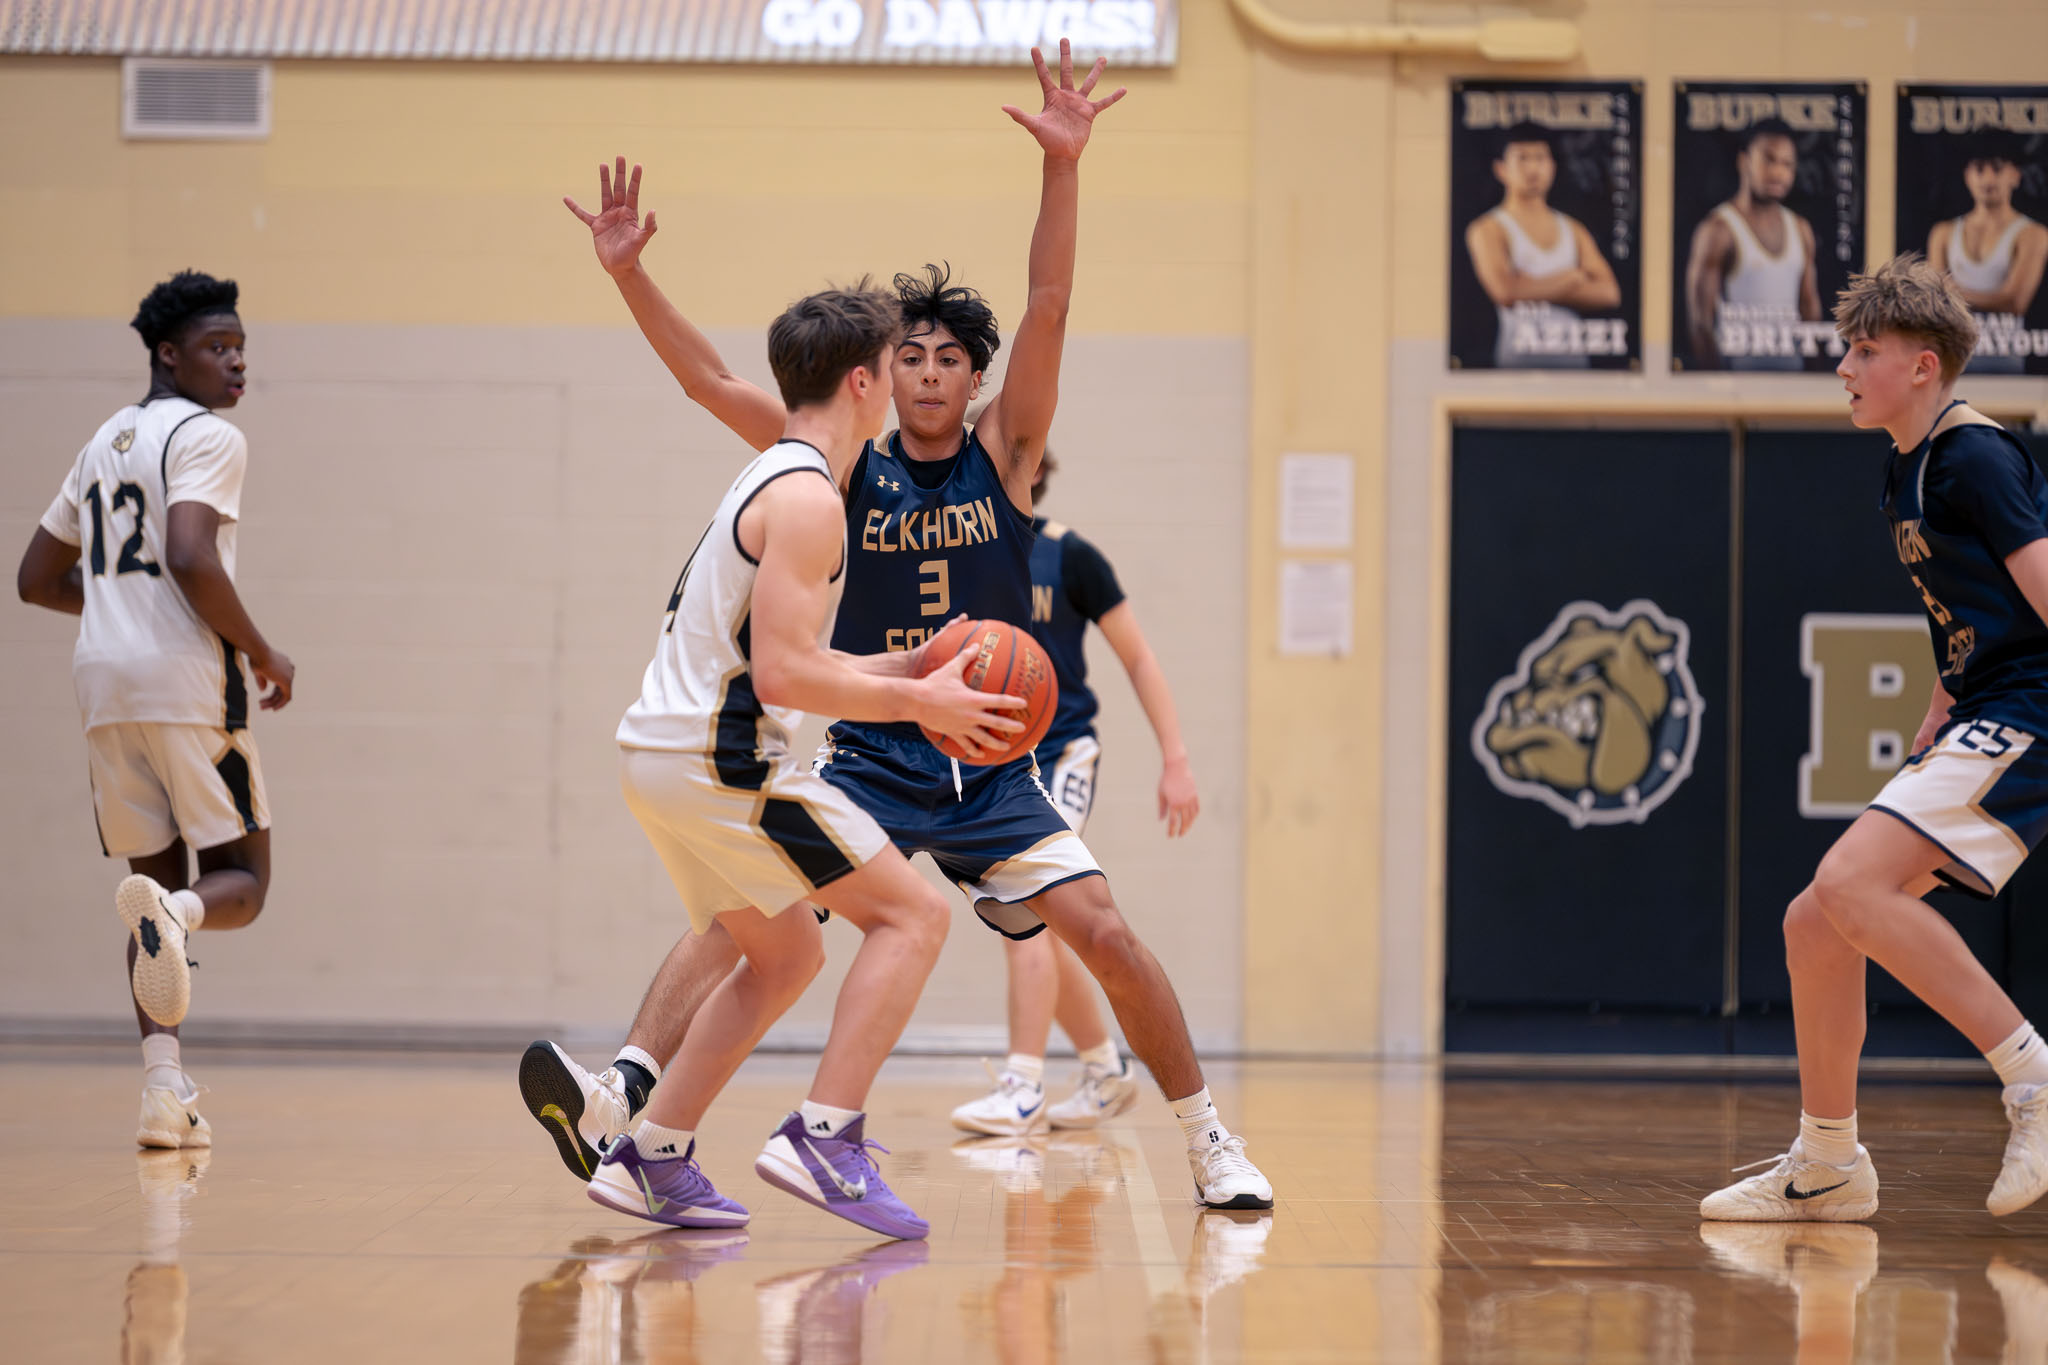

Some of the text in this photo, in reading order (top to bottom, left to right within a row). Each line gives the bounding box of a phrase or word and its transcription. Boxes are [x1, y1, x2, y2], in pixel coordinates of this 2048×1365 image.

[761, 0, 1157, 48] GO DAWGS!
[1463, 91, 1615, 129] BURKE
[1686, 93, 1838, 131] BURKE
[84, 480, 162, 577] 12
[862, 496, 999, 552] ELKHORN
[918, 559, 950, 616] 3
